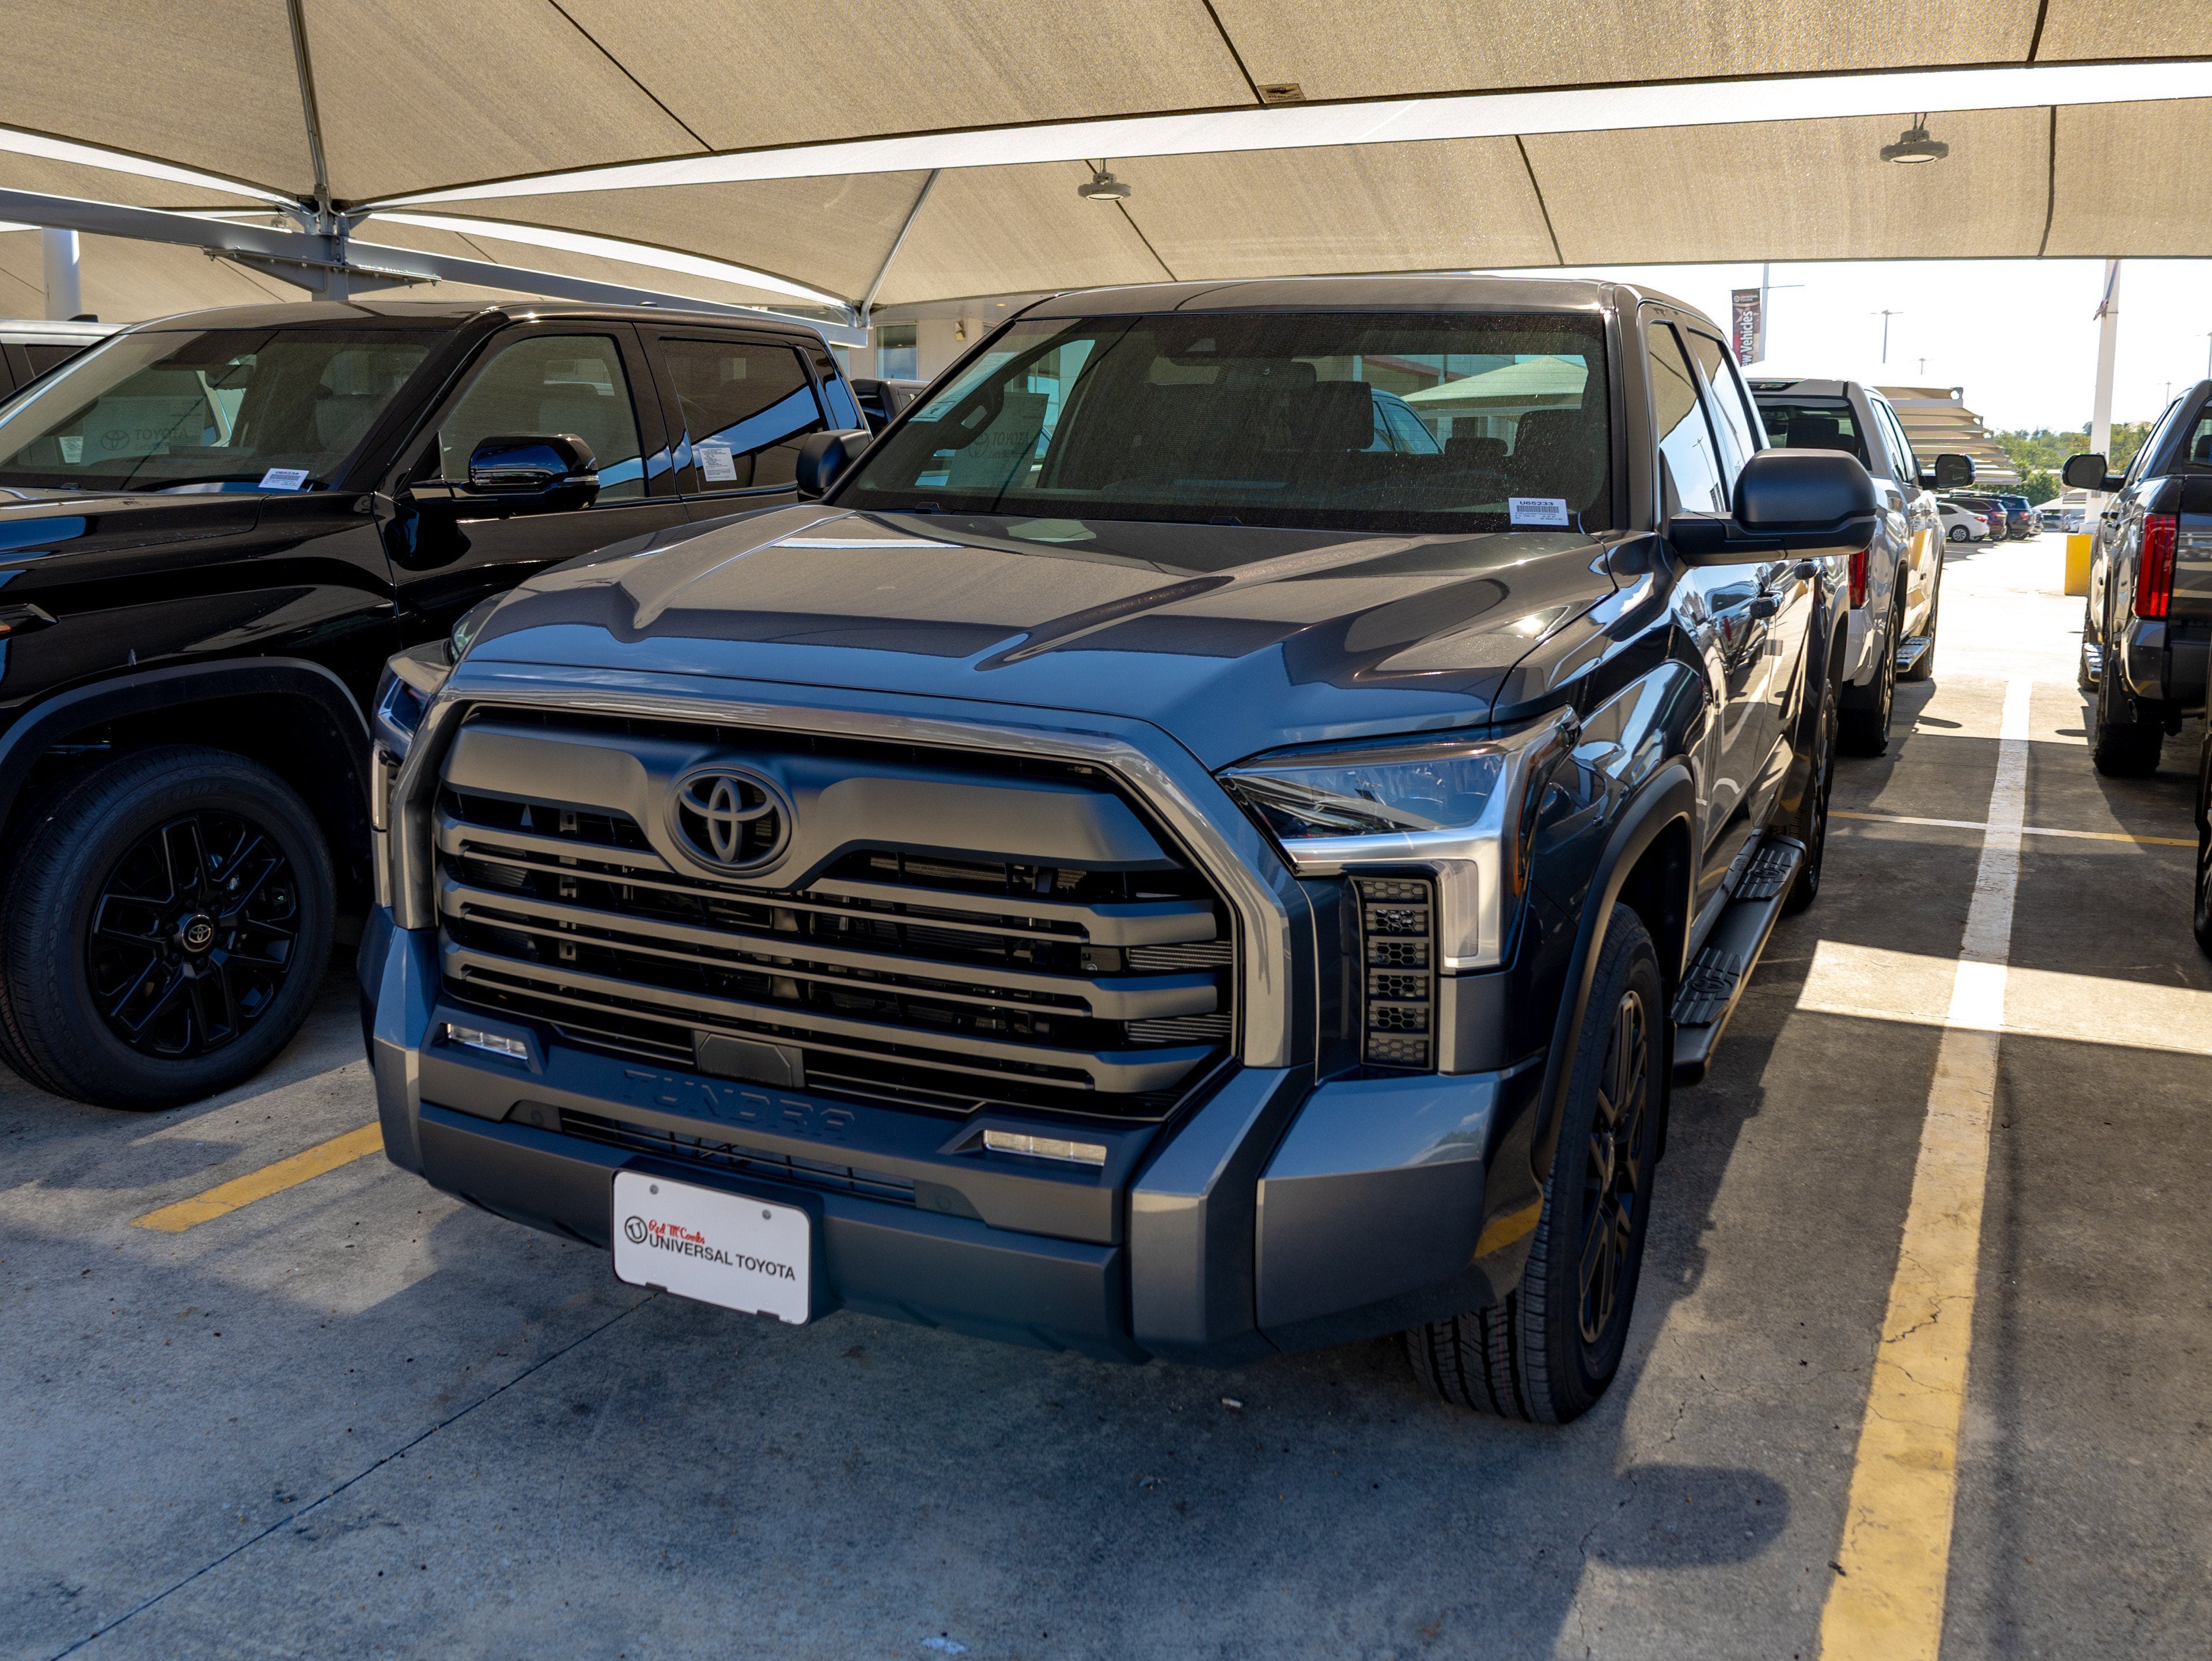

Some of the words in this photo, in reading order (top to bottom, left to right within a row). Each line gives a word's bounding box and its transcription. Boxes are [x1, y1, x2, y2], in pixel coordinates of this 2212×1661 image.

[1740, 311, 1753, 353] Vehicles
[624, 1069, 855, 1140] TUNDRA
[649, 1234, 733, 1266] UNIVERSAL
[736, 1254, 796, 1281] TOYOTA
